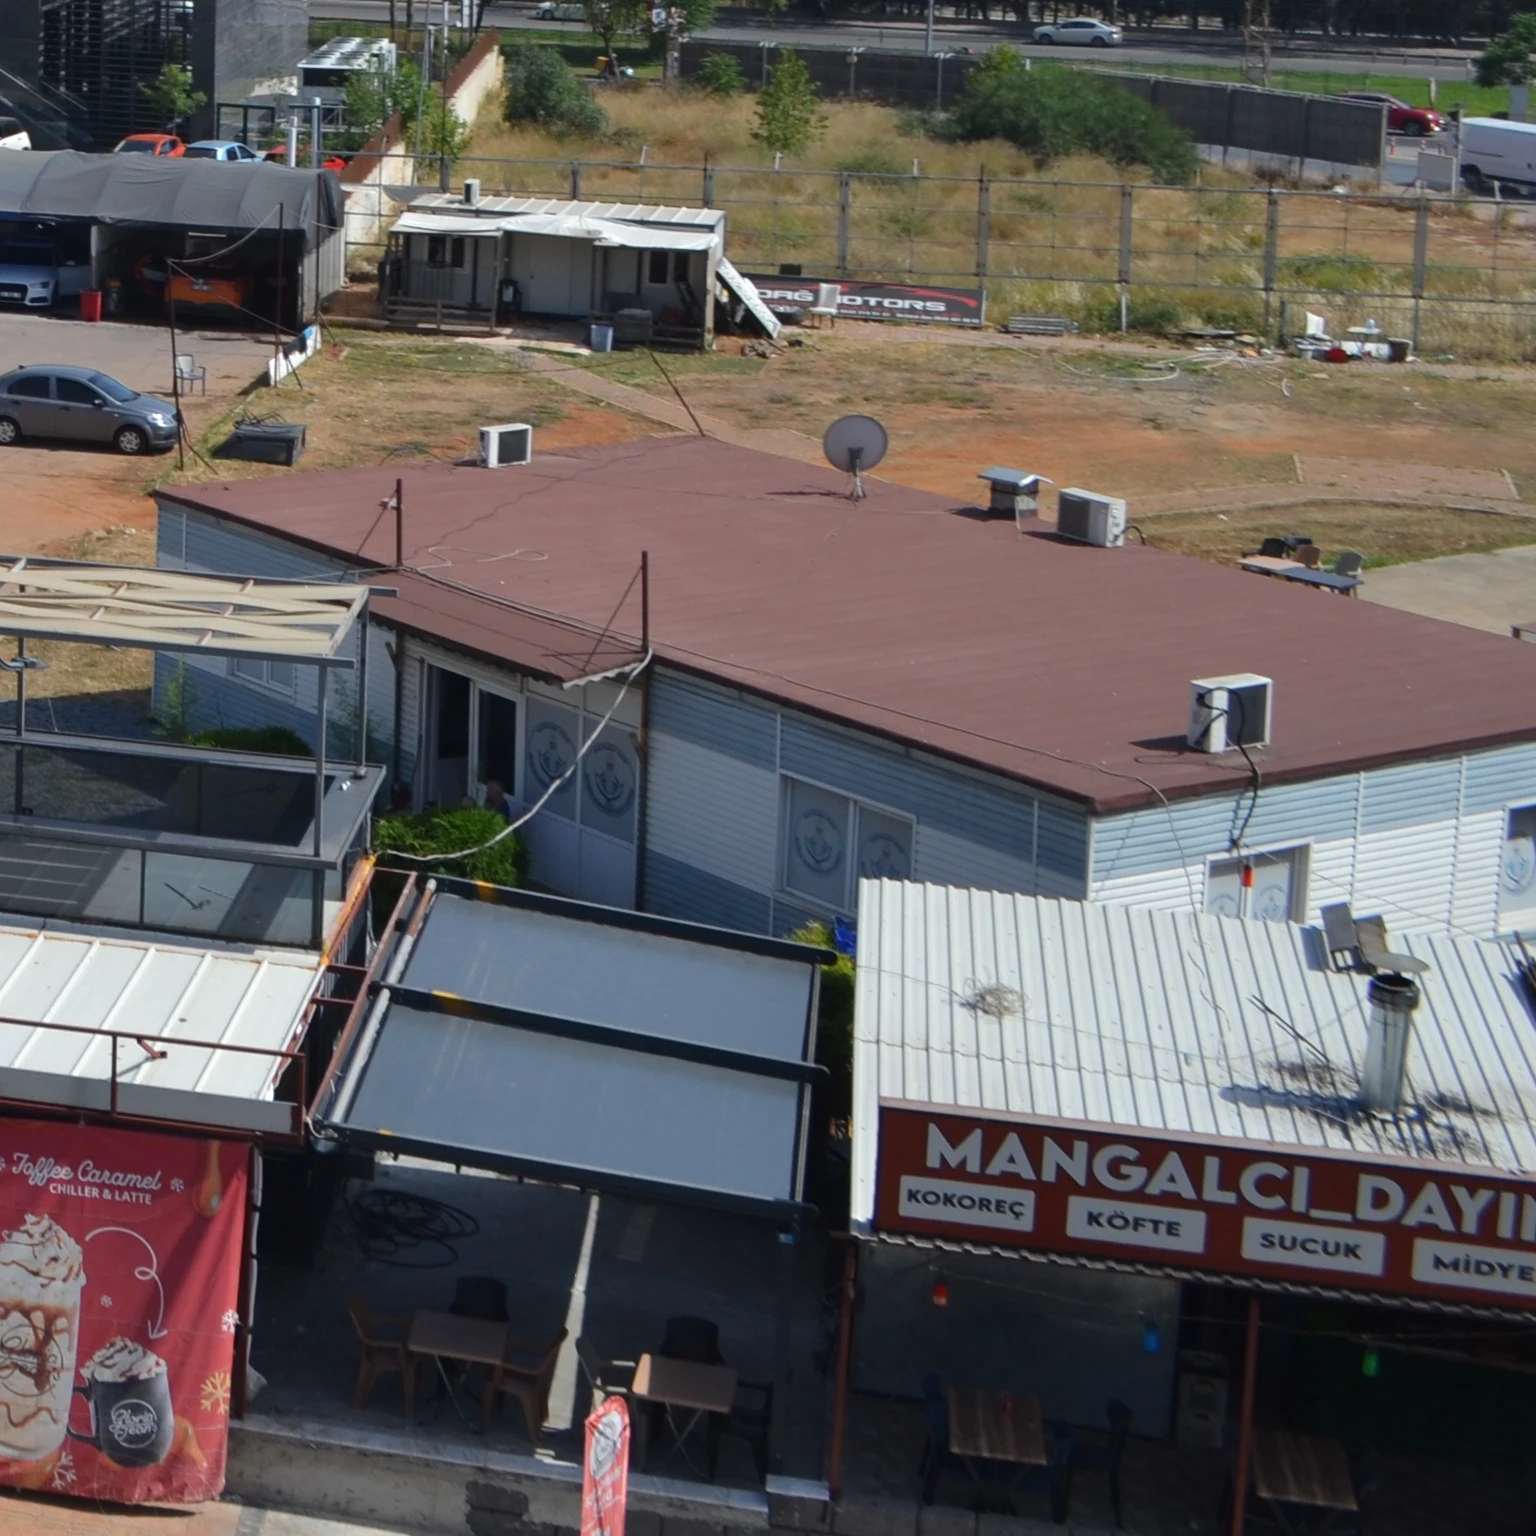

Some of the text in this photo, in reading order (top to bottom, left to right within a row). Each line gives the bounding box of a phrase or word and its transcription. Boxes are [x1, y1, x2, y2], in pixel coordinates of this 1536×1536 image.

[11, 1152, 162, 1191] Toffee Caramel
[49, 1182, 152, 1205] CHILLER & LATTE
[907, 1187, 1026, 1221] KOKOREÇ
[1086, 1209, 1182, 1238] KÖFTE
[1260, 1232, 1363, 1261] SUCUK
